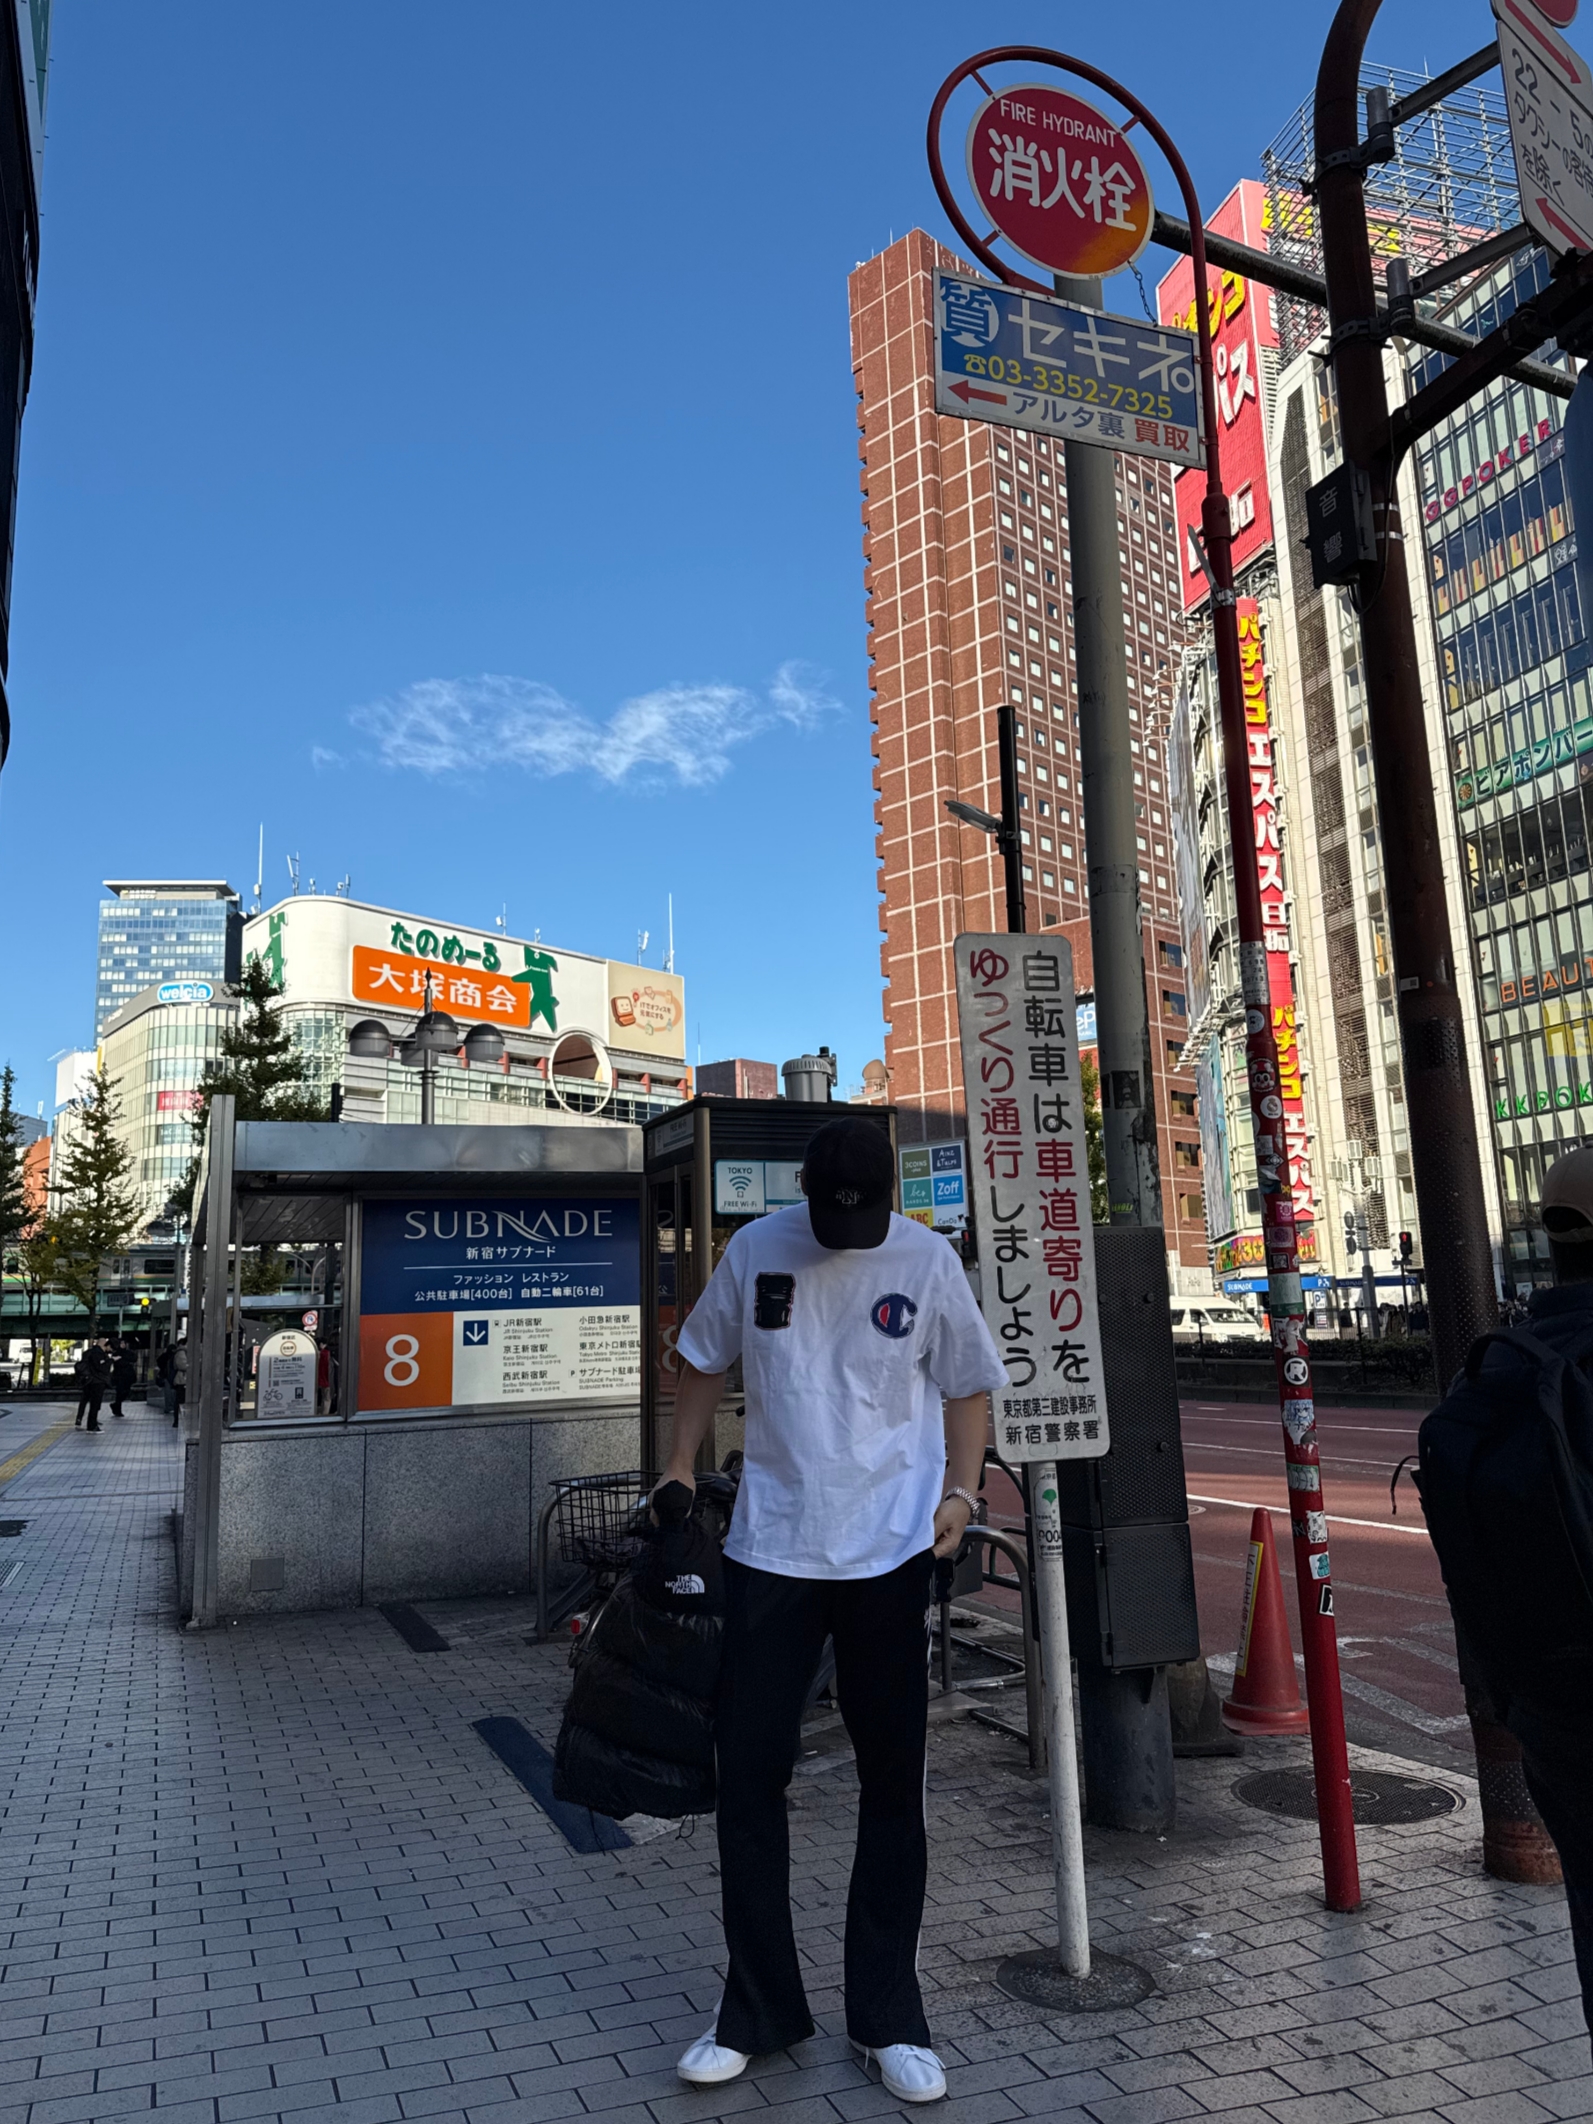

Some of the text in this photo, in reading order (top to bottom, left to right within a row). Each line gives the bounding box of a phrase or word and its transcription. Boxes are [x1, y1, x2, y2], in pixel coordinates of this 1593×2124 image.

[1000, 98, 1117, 147] FIRE HYDRANT
[988, 128, 1136, 232] 消火栓
[1521, 143, 1565, 207] を除く
[940, 281, 999, 347] 質
[988, 355, 1174, 419] 03-3352-7325
[1012, 391, 1190, 453] アルタ裏 買取
[1425, 418, 1551, 522] GGPOKER
[1319, 486, 1343, 564] 音響
[391, 922, 501, 972] たのめーる
[161, 983, 207, 1000] welcia
[369, 963, 517, 1013] 大塚商会
[728, 1167, 753, 1175] TOKYO
[970, 948, 1037, 1388] ゆっくり通行しましょう
[1022, 949, 1090, 1383] 自転車は車道寄りを
[740, 1200, 757, 1208] Wi-Fi
[937, 1181, 960, 1196] Zoff
[404, 1209, 613, 1243] SUBNADE
[466, 1245, 556, 1260] 新宿サブナード
[453, 1272, 569, 1285] ファッション レストラン
[503, 1317, 542, 1327] JR新宿駅
[579, 1314, 630, 1325] 小田急新宿駅
[384, 1334, 420, 1387] 8
[503, 1344, 548, 1354] 京王新宿駅
[503, 1370, 548, 1381] 西武新宿駅
[1003, 1394, 1097, 1420] 東京都第三建設事務所
[1005, 1419, 1099, 1446] 新宿警察署
